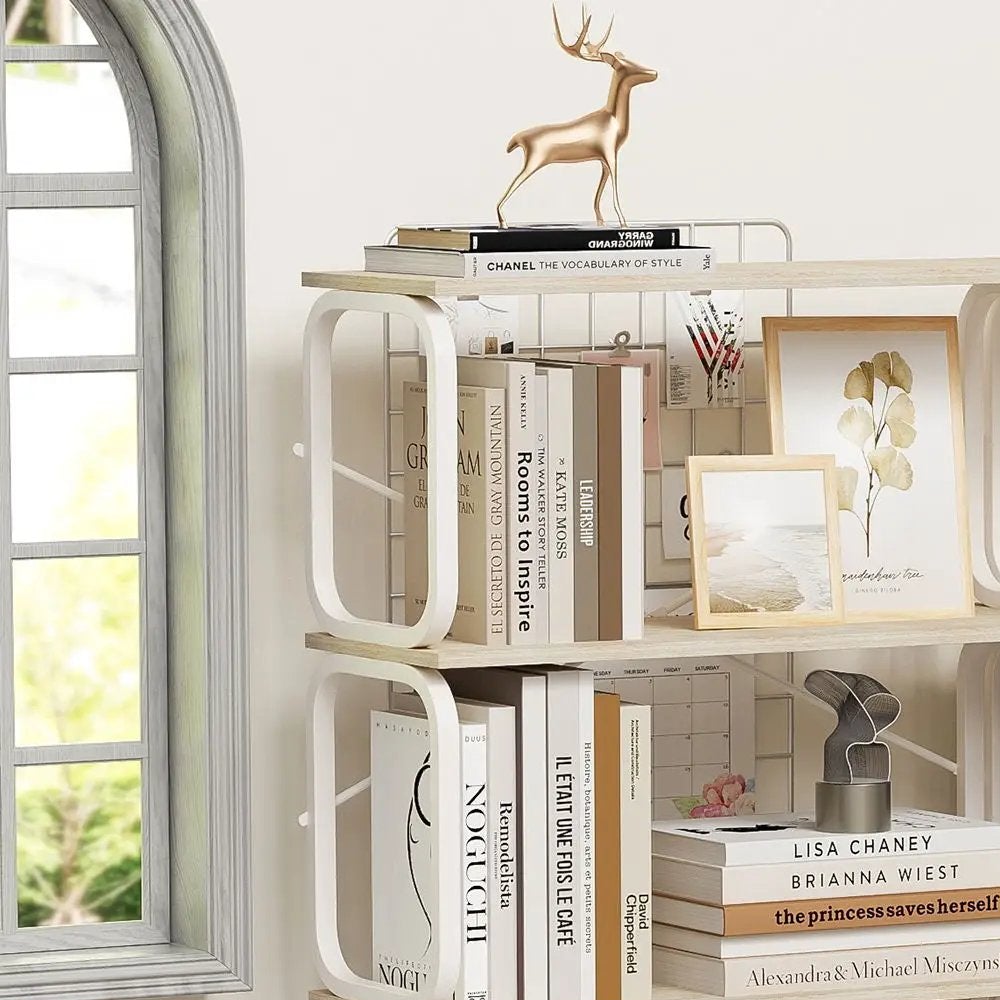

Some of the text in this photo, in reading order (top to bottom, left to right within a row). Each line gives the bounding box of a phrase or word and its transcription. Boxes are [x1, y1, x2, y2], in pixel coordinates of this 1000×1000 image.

[487, 258, 682, 271] CHANEL THE VOCABULARY STYLE
[520, 375, 528, 430] ANNIE KELLY
[491, 405, 503, 617] SECRETO GRAY MOUNTAIN
[538, 471, 546, 514] WALKER
[556, 471, 567, 560] KATE MOSS
[580, 479, 594, 547] LEADERSHIP
[514, 452, 534, 632] Rooms to Inspire
[538, 516, 546, 550] STORY
[538, 553, 546, 590] TELLER
[465, 783, 487, 945] NOGUCHI
[500, 800, 514, 909] Remodelista
[556, 819, 572, 905] UNE FOIS LE
[794, 836, 932, 858] LISA CHANEY
[792, 864, 960, 889] BRIANNA WIEST
[626, 894, 638, 974] Chipperfield
[638, 894, 648, 929] David
[775, 895, 1000, 928] the princess saves herself
[853, 957, 918, 981] Michael
